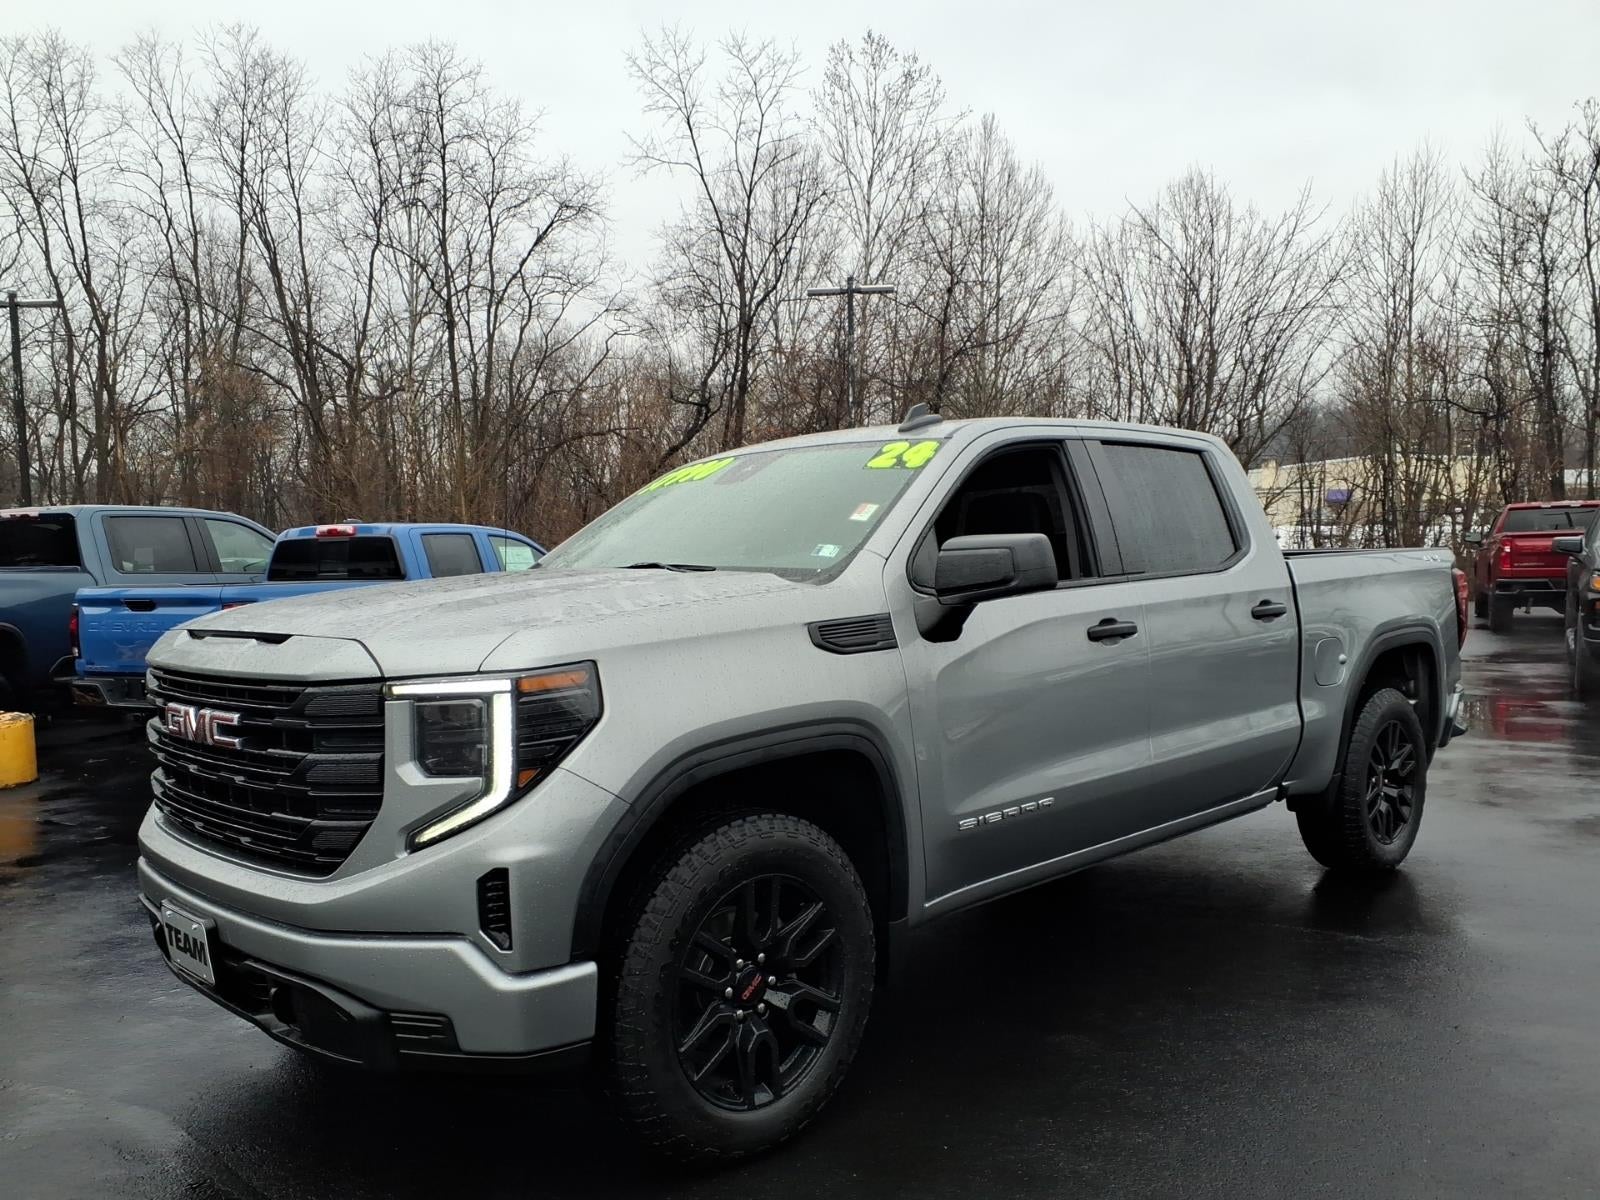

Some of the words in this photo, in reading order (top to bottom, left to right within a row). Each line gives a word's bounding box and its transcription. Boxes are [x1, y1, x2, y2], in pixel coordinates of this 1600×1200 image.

[866, 441, 940, 469] 24
[164, 702, 245, 750] GMC
[959, 797, 1055, 831] SIERRA
[165, 922, 208, 966] TEAM
[742, 973, 762, 1000] GMC
